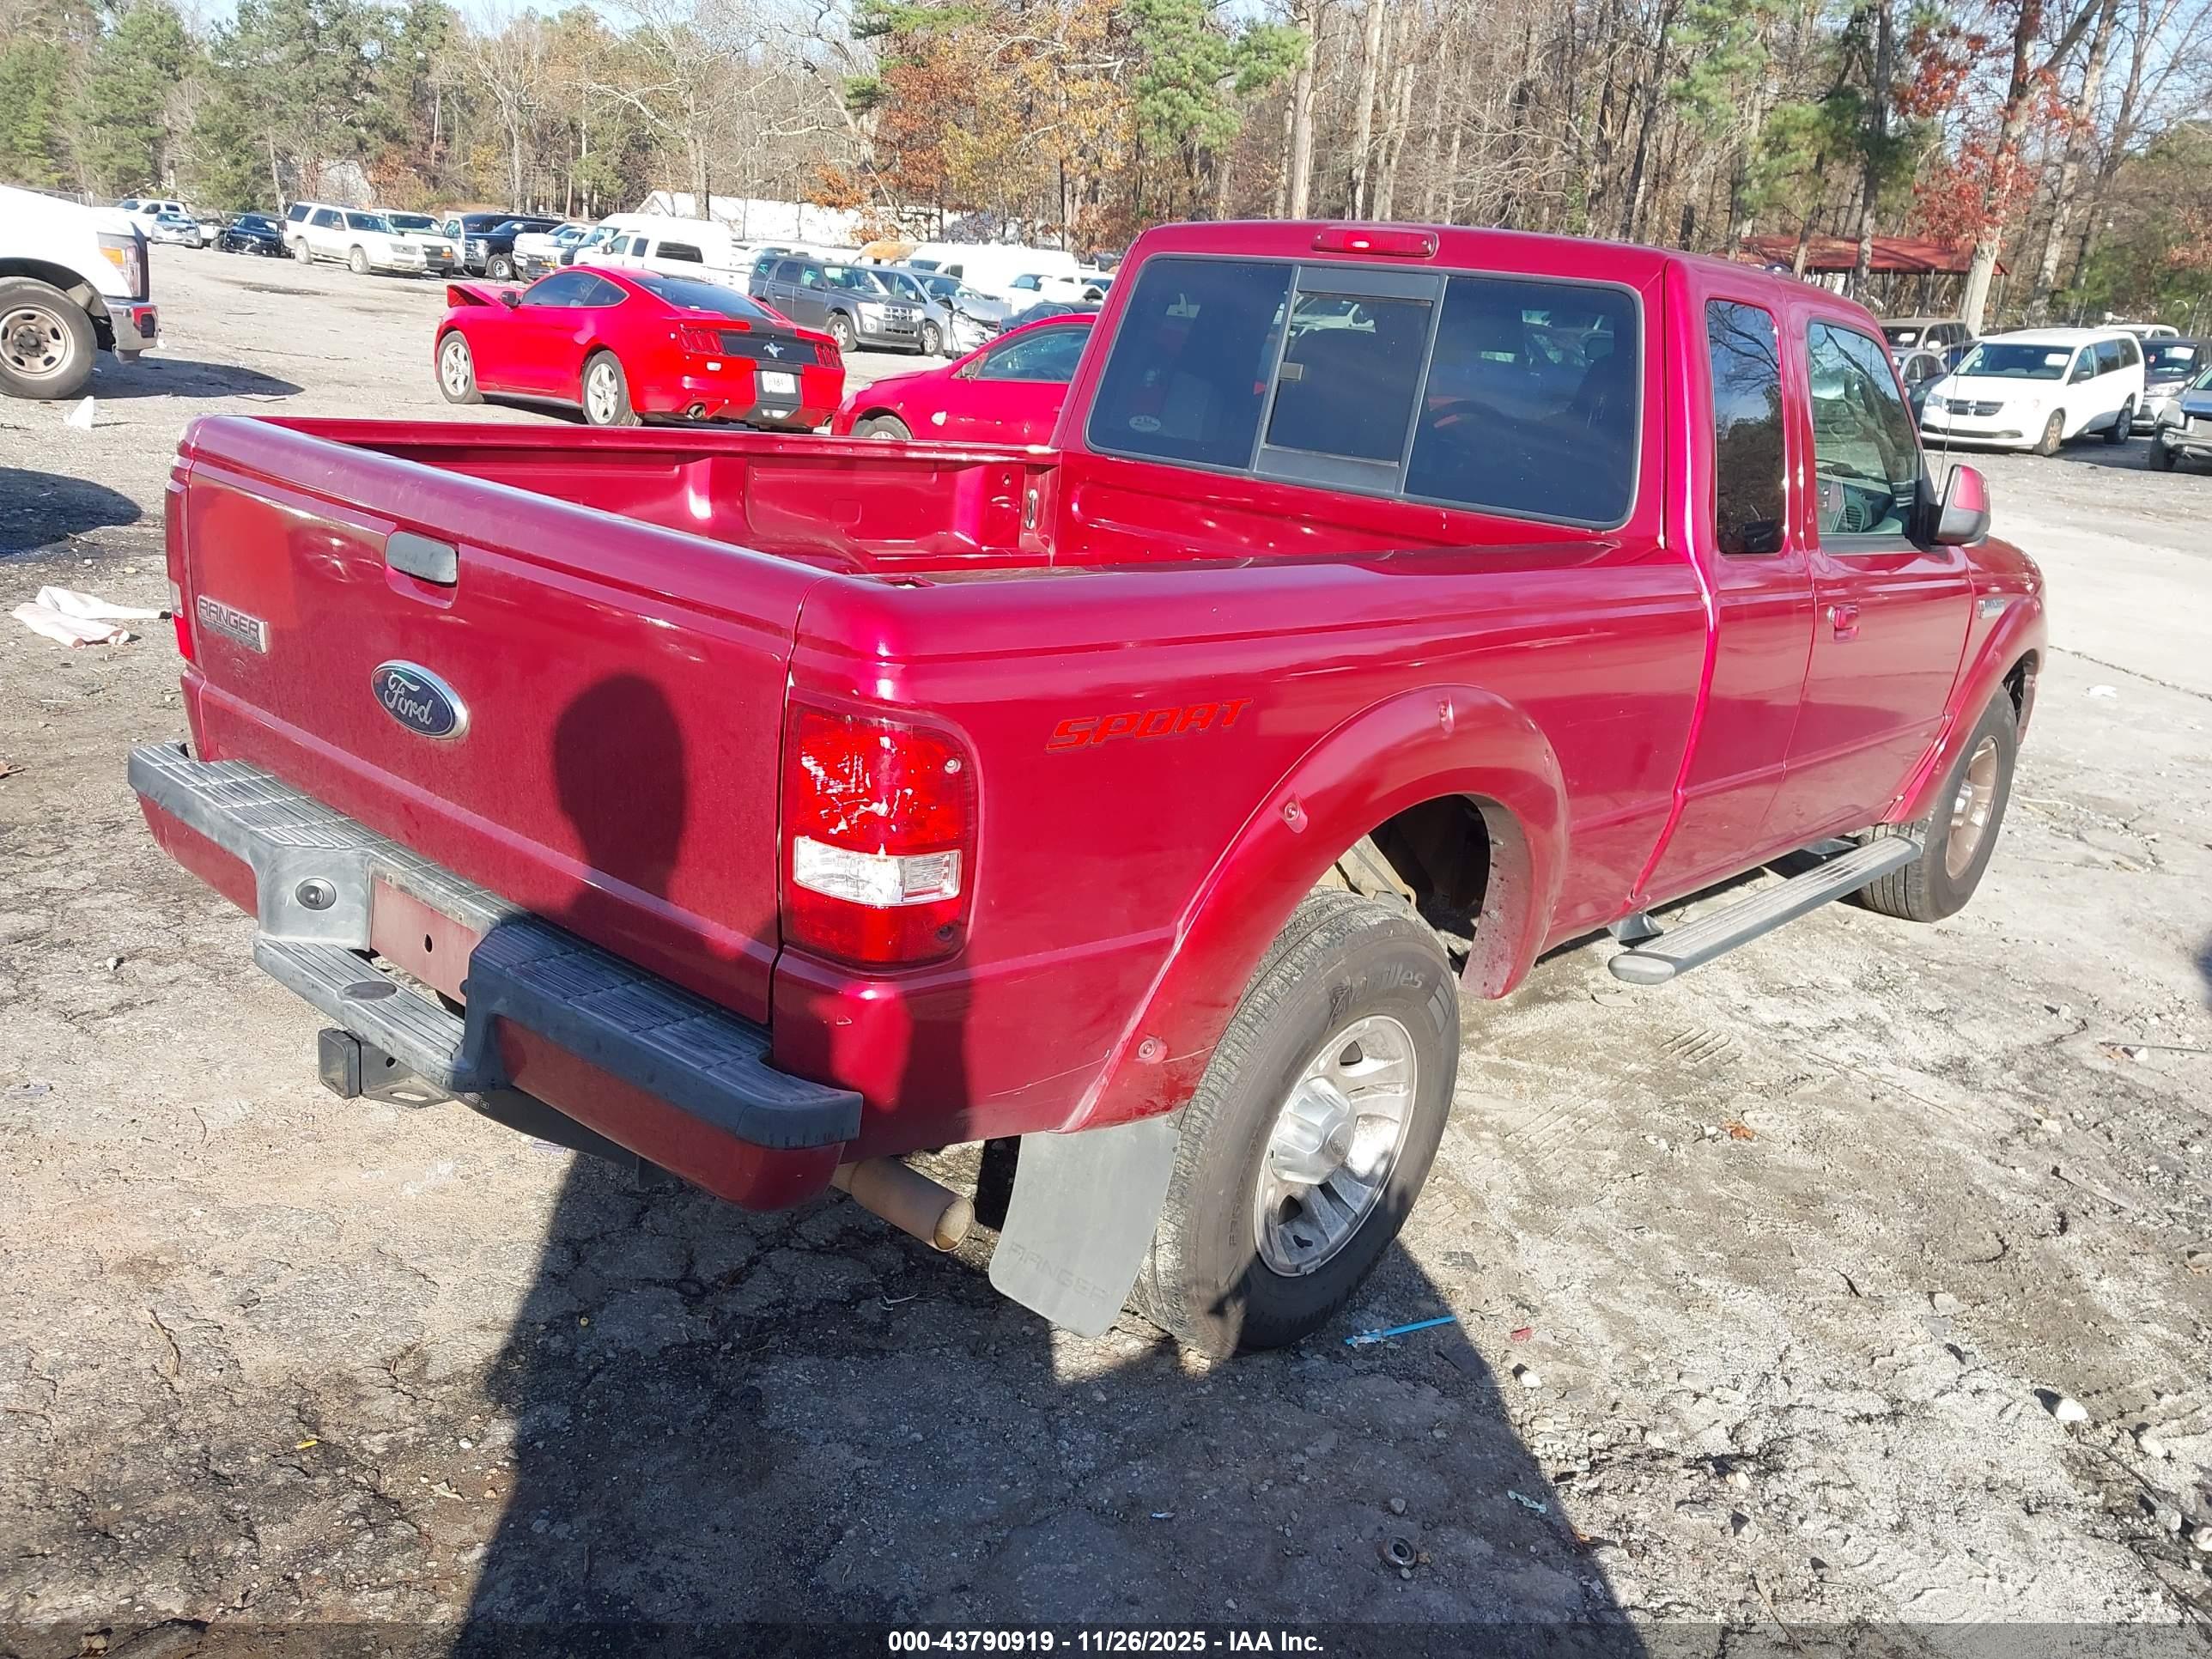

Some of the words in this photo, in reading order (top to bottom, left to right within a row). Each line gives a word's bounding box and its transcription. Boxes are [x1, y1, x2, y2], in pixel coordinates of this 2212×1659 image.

[198, 598, 260, 641] RANGER
[384, 671, 434, 726] Ford
[1044, 696, 1255, 751] SPORT
[1010, 1243, 1113, 1301] RANGER
